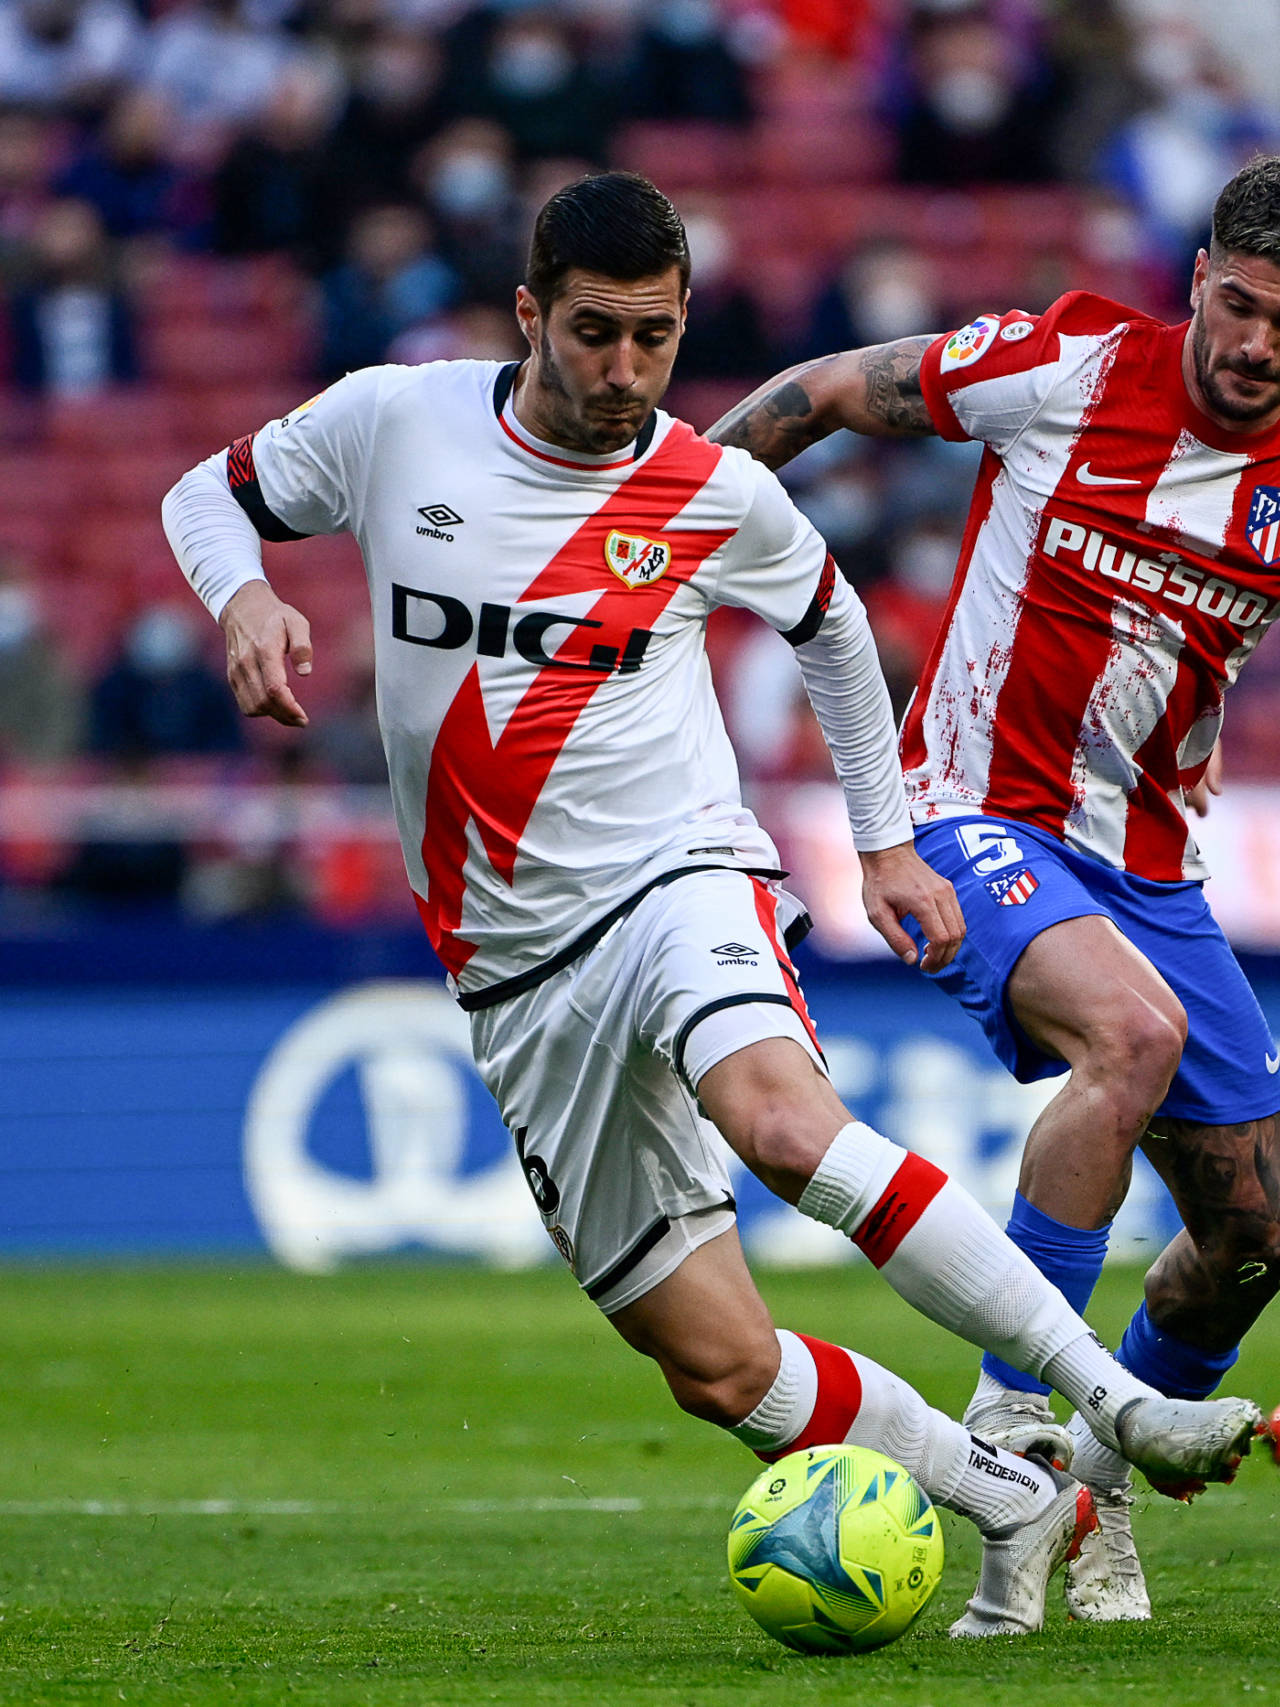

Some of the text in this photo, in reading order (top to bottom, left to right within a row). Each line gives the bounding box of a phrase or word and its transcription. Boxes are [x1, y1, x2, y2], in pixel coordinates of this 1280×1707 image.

[415, 525, 455, 543] umbro
[1042, 516, 1269, 628] Plus500
[391, 582, 656, 675] DIGI
[954, 823, 1024, 877] 5
[716, 956, 759, 967] umbro
